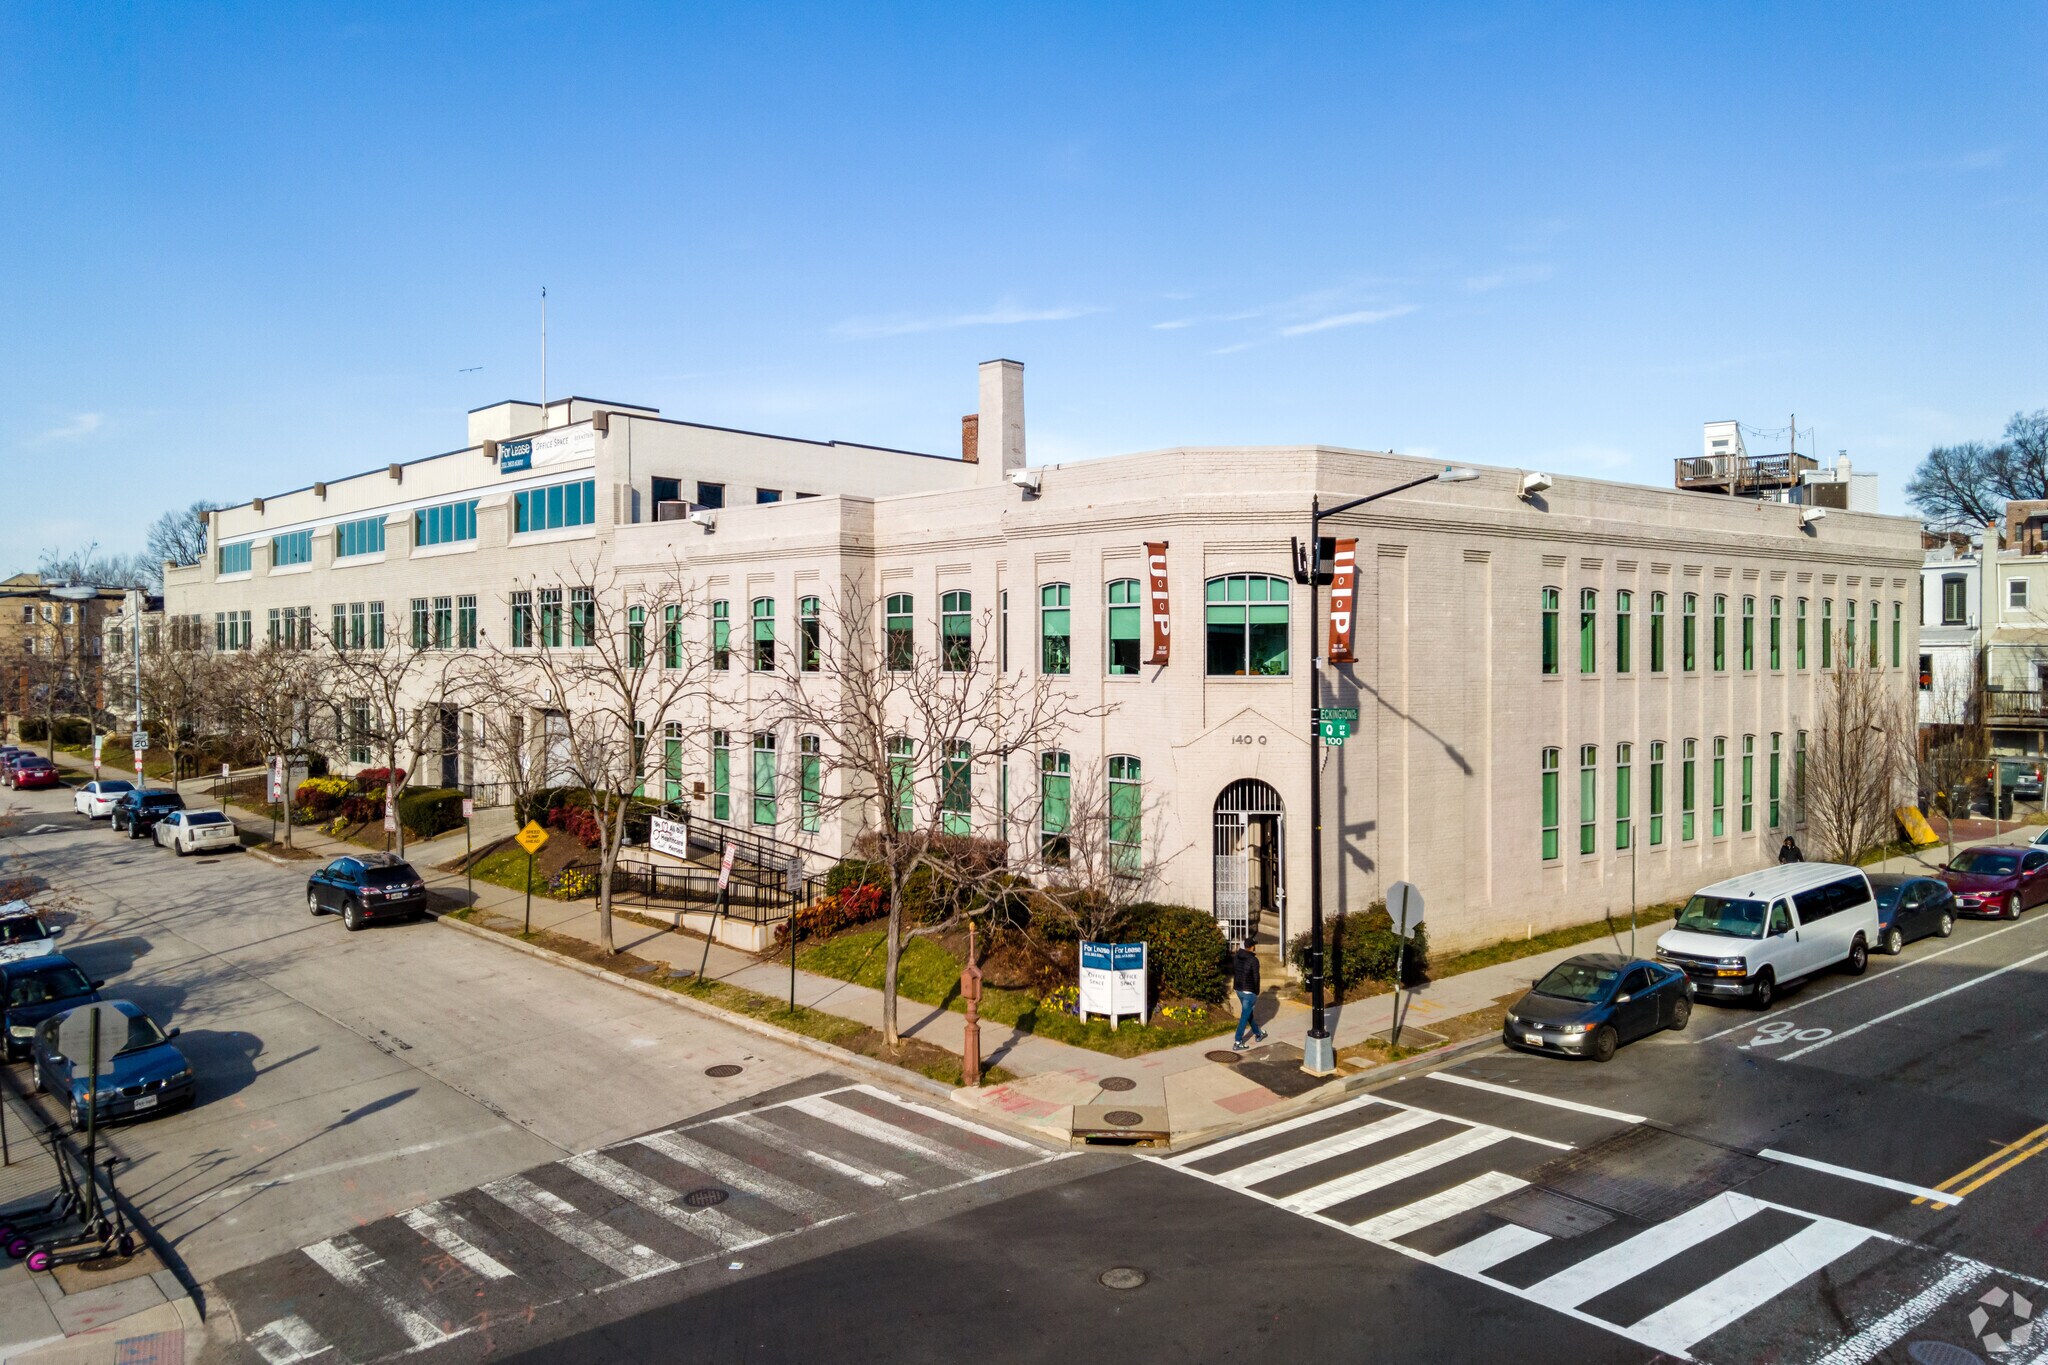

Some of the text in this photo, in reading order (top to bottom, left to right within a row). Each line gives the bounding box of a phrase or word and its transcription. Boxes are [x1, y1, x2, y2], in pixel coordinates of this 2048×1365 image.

[501, 443, 530, 459] For Lease
[1326, 725, 1333, 736] Q
[134, 740, 147, 748] 20
[1327, 737, 1342, 745] 100
[1084, 944, 1110, 954] For Lease
[1125, 946, 1141, 954] Lease
